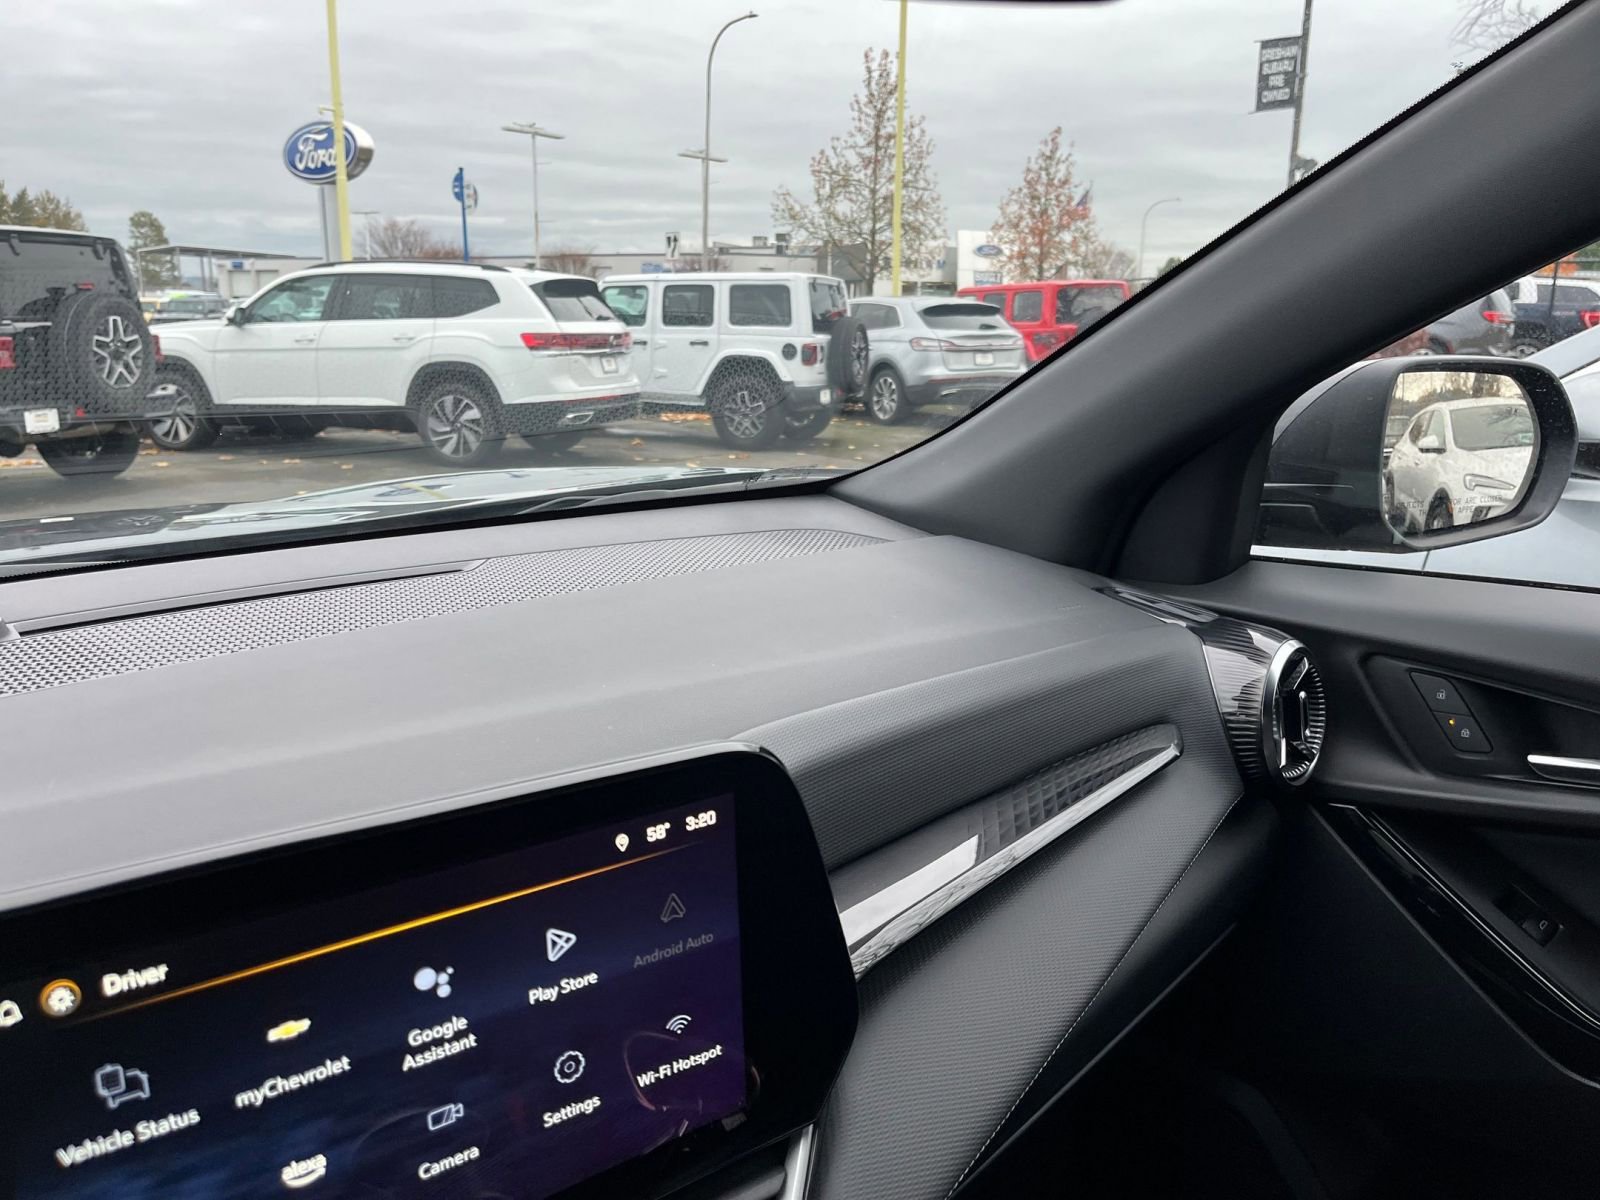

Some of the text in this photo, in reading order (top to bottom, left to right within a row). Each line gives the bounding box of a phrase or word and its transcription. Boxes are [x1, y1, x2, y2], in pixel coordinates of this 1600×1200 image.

[685, 810, 717, 831] 3:20
[633, 933, 714, 968] Android Auto
[102, 963, 169, 997] Driver
[529, 971, 599, 1004] Play Store
[407, 1015, 469, 1047] Google
[402, 1032, 478, 1072] Assistant
[636, 1044, 723, 1088] Wi-Fi Hotspot
[234, 1055, 352, 1109] myChevrolet
[543, 1095, 602, 1128] Settings
[55, 1108, 201, 1168] Vehicle Status
[281, 1154, 327, 1181] alexa
[417, 1146, 480, 1180] Camera
